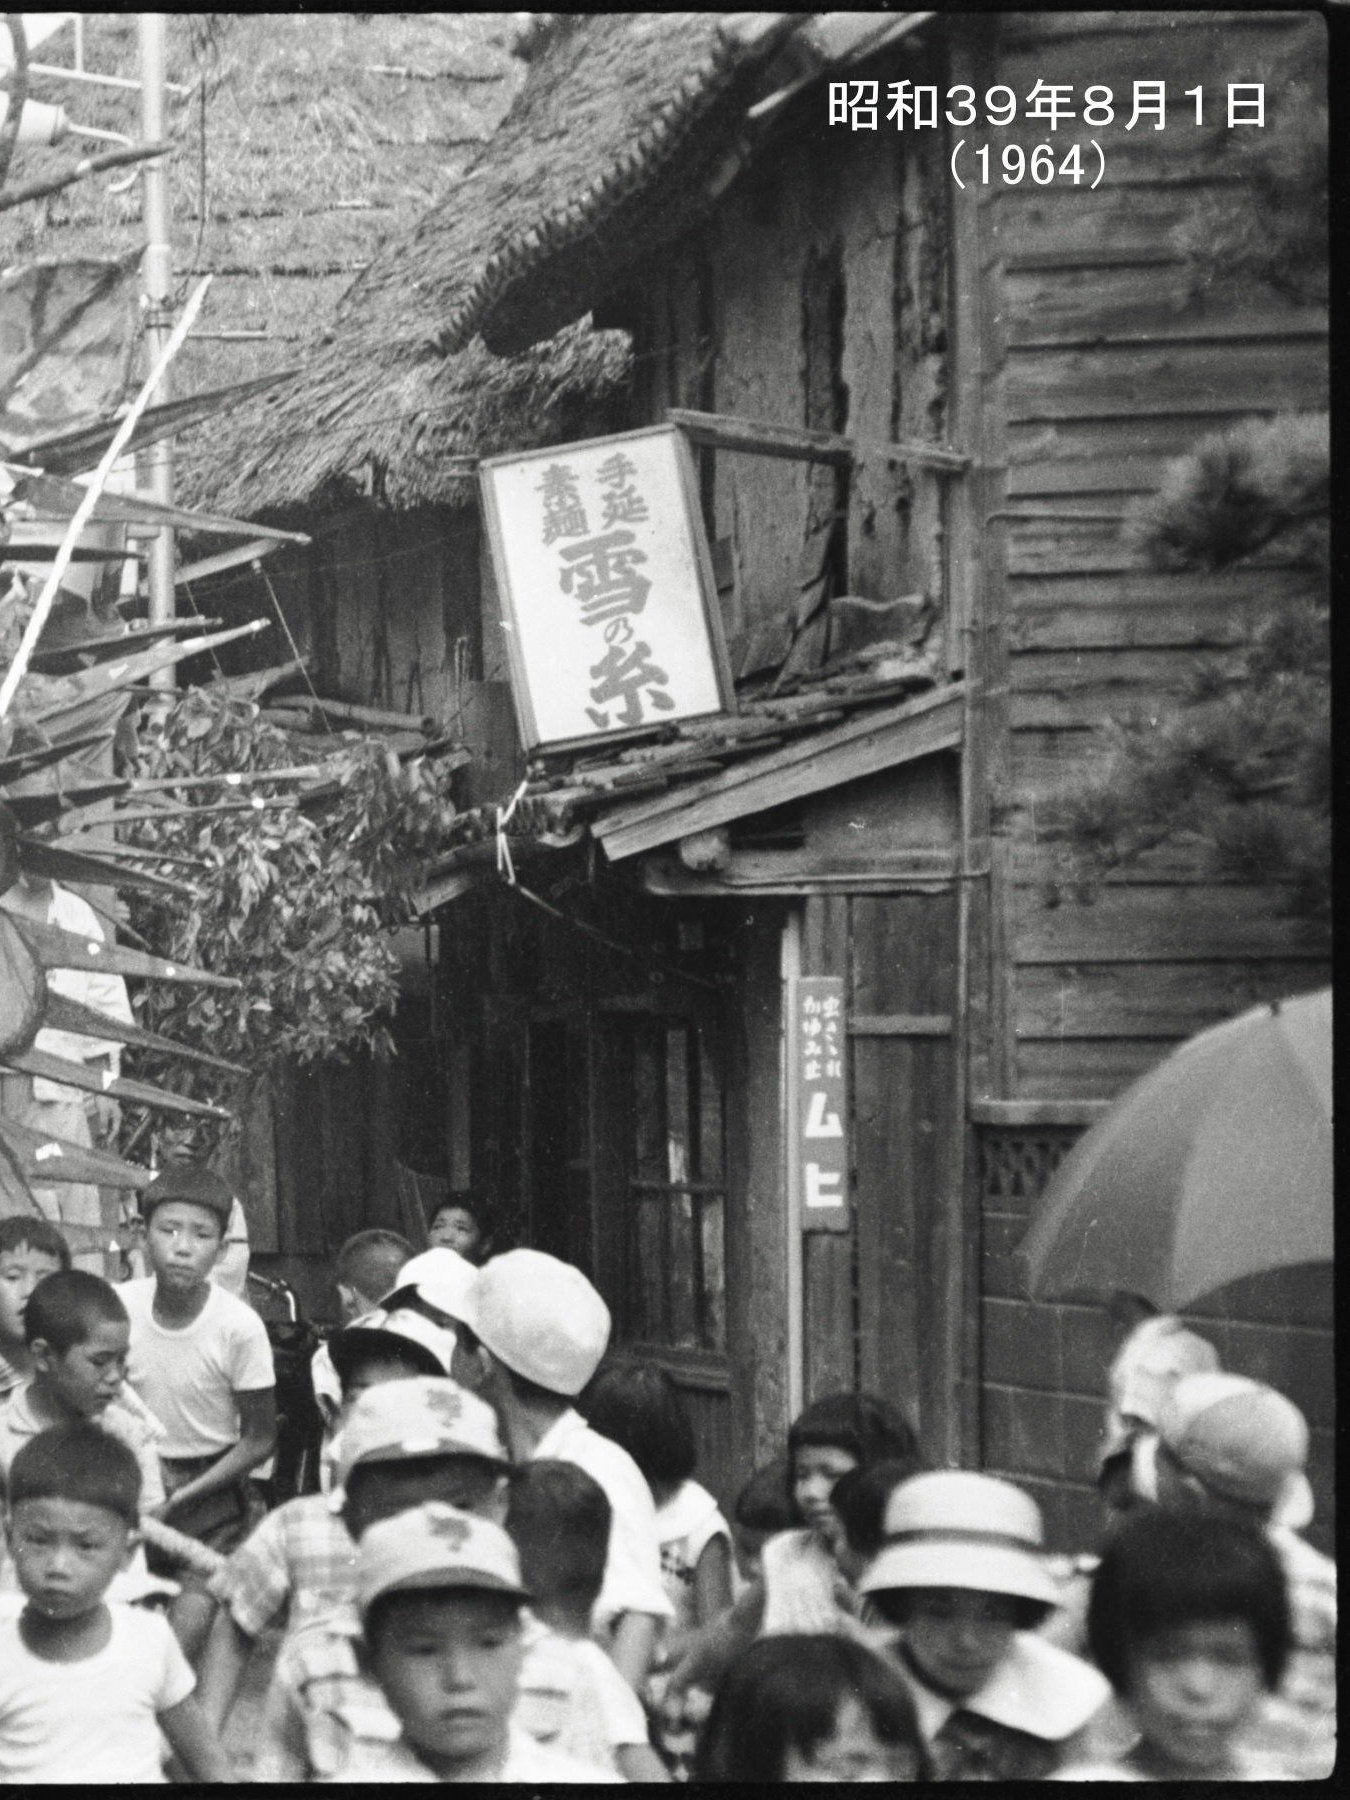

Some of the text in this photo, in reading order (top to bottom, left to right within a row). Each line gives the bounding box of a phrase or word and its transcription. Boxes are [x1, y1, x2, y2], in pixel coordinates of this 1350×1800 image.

[596, 451, 649, 530] 手延
[558, 529, 676, 728] 雪の糸
[805, 1092, 843, 1207] ムヒ
